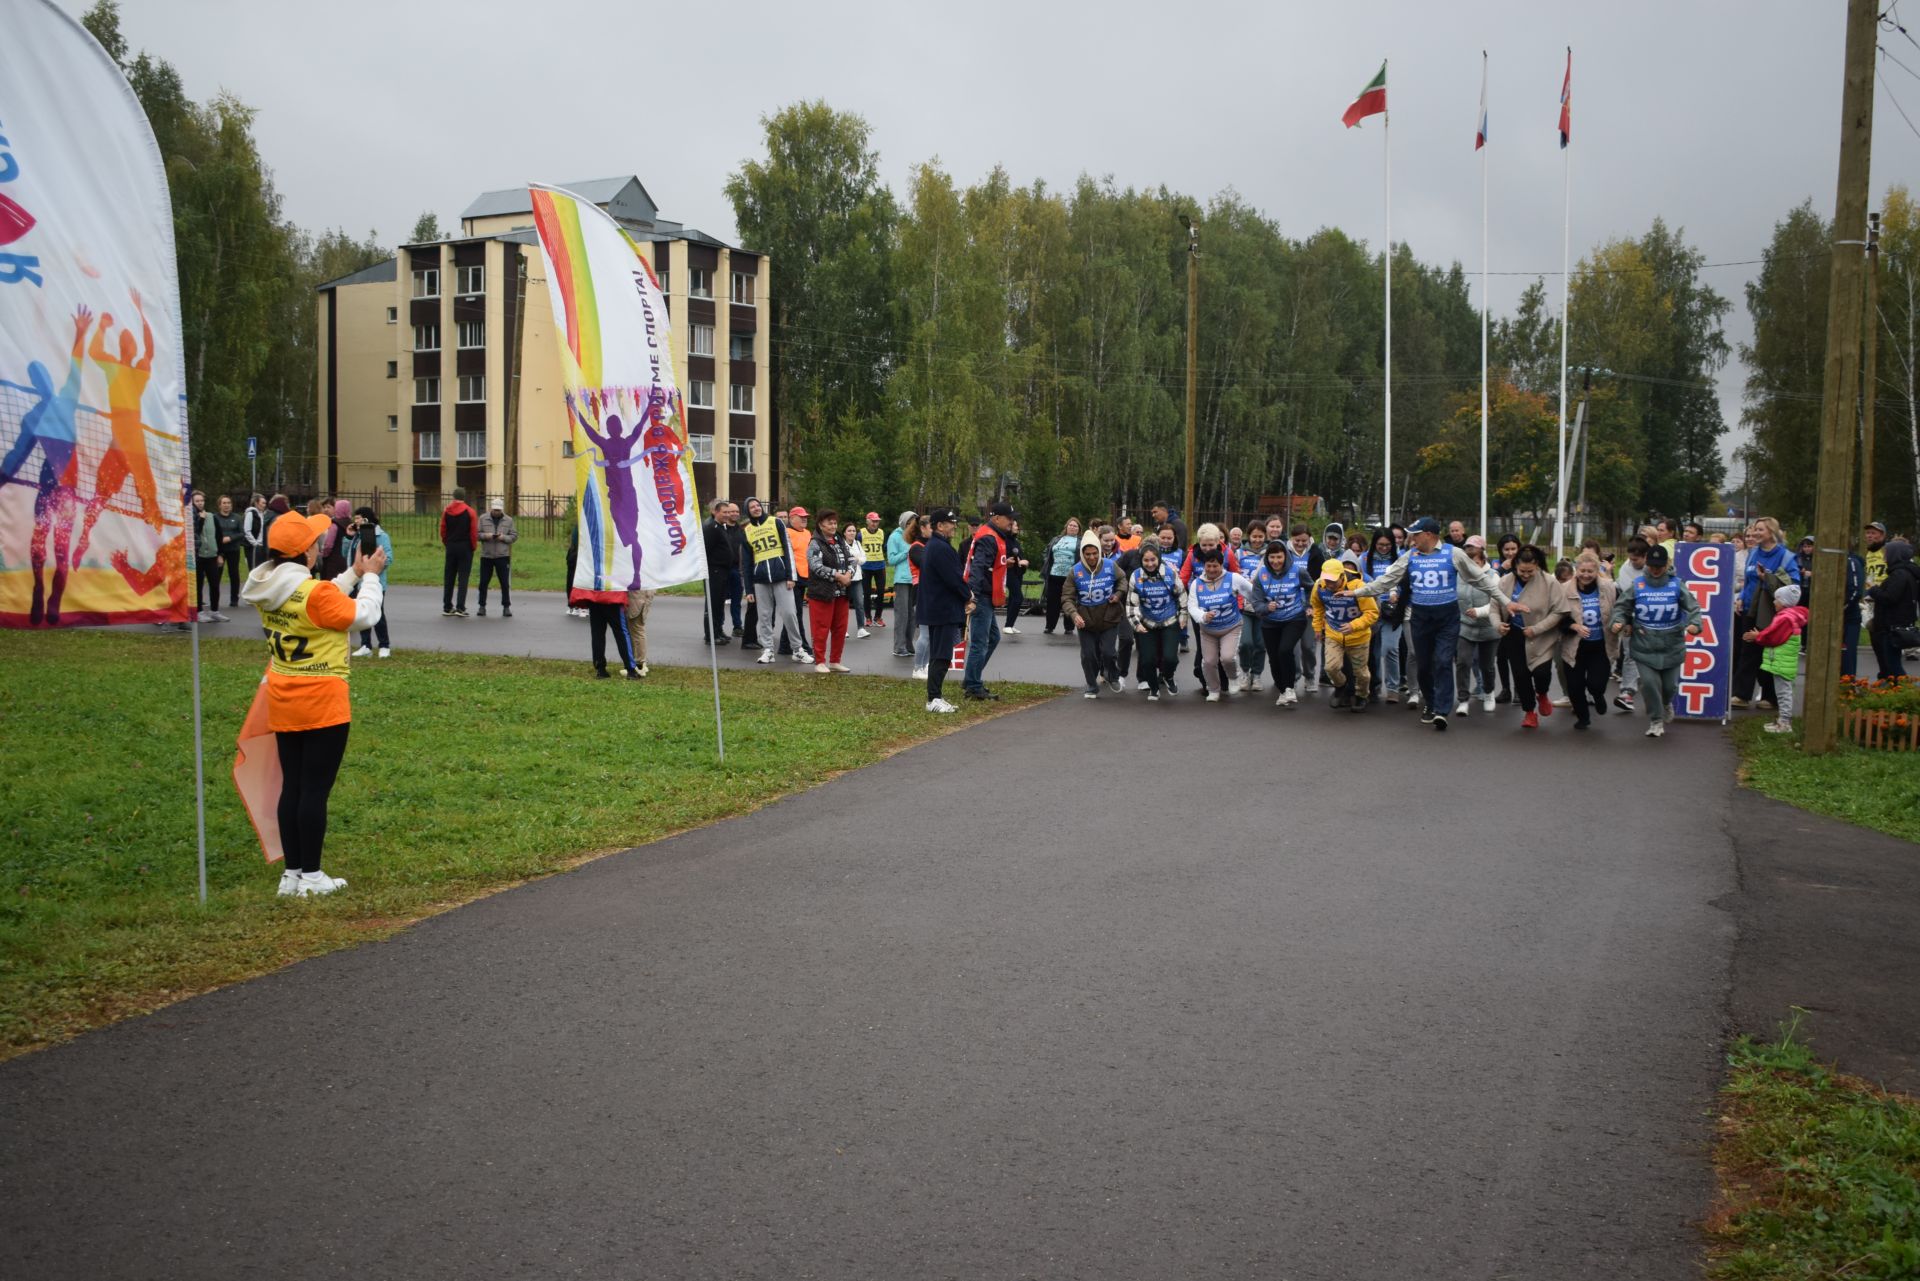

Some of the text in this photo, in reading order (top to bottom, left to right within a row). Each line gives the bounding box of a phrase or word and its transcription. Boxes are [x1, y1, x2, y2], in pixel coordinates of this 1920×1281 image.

[632, 270, 683, 556] МОЛОДЕЖЬ В РИТМЕ СПОРТА!
[752, 535, 778, 552] 315
[864, 543, 881, 553] 313
[1410, 570, 1449, 588] 281
[1079, 584, 1114, 603] 283
[267, 615, 289, 627] РАЙОН
[1324, 604, 1361, 620] 278
[1635, 603, 1678, 621] 277
[1678, 546, 1720, 715] СТАРТ
